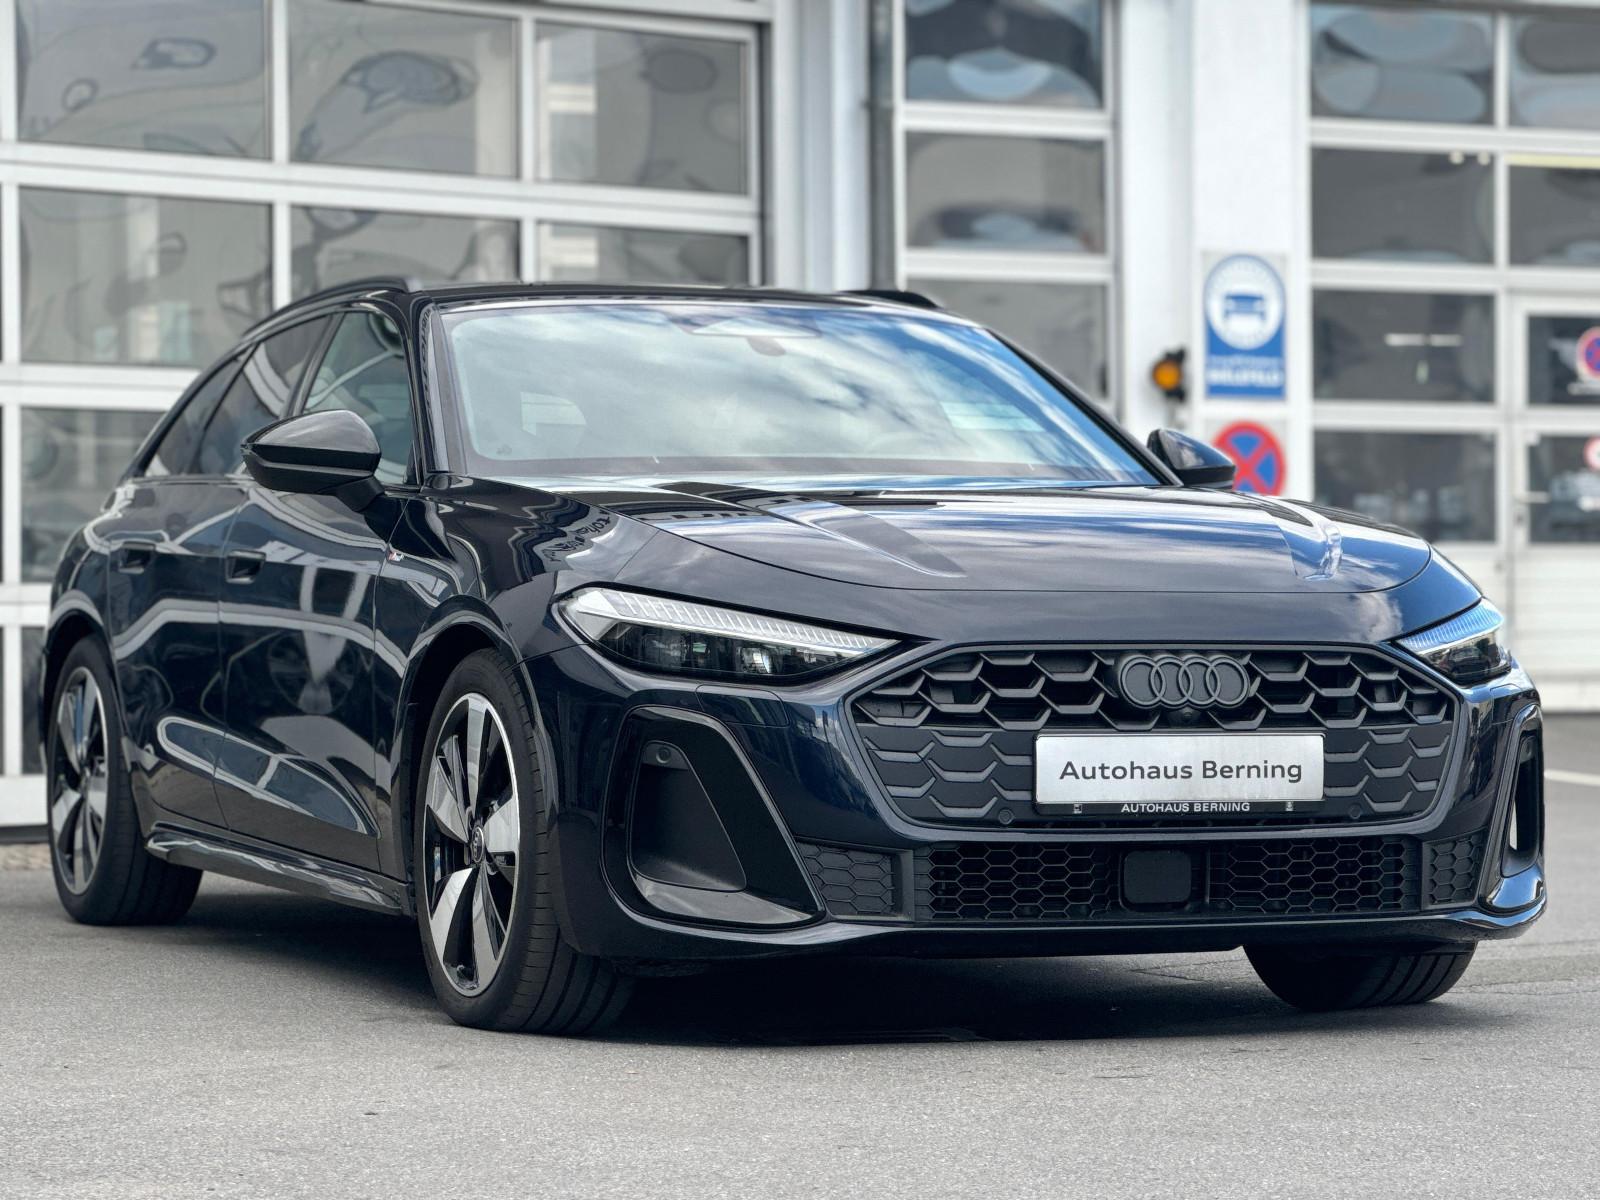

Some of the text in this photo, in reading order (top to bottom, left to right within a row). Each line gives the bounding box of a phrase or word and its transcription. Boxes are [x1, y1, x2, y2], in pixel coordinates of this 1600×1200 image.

[1059, 759, 1302, 783] Autohaus Berning
[1121, 802, 1250, 813] AUTOHAUS BERNING
